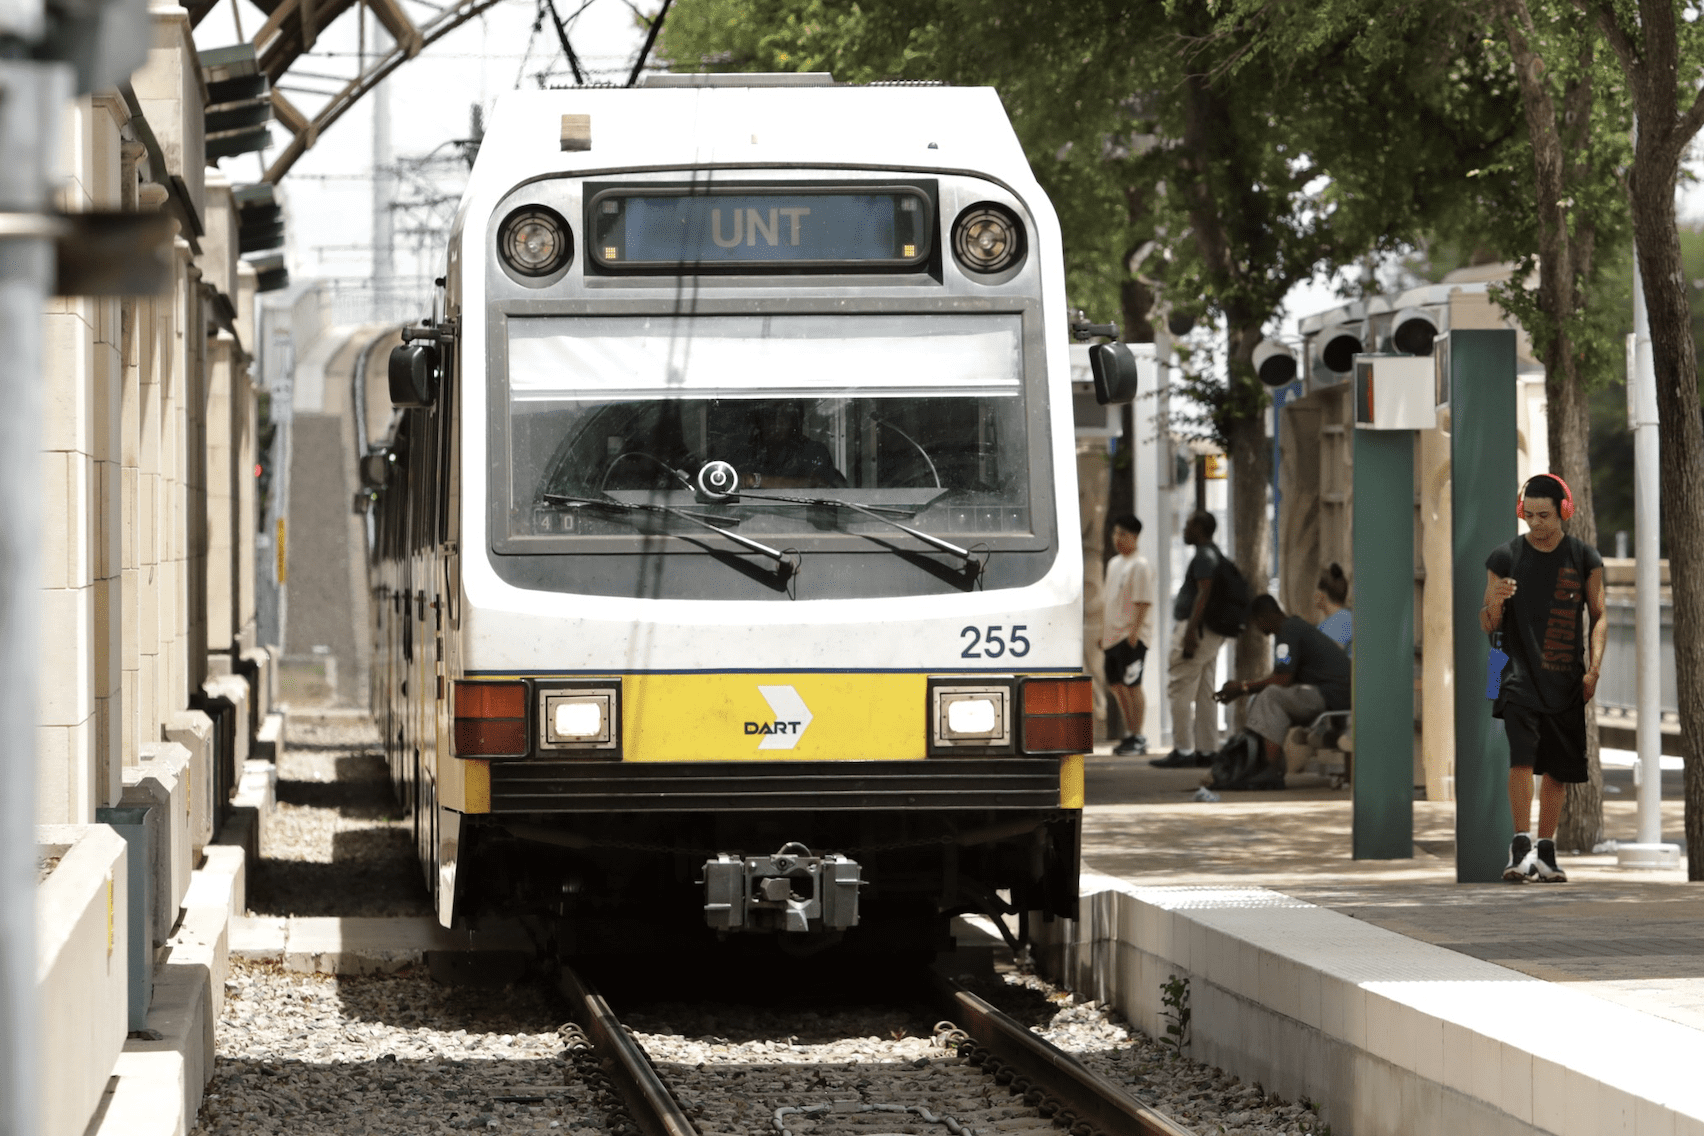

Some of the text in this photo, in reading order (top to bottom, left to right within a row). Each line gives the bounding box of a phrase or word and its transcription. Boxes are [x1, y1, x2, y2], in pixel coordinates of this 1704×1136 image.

[712, 207, 811, 248] UNT
[1541, 567, 1581, 662] LAS VEGAS
[960, 625, 1031, 659] 255
[743, 721, 802, 735] DART
